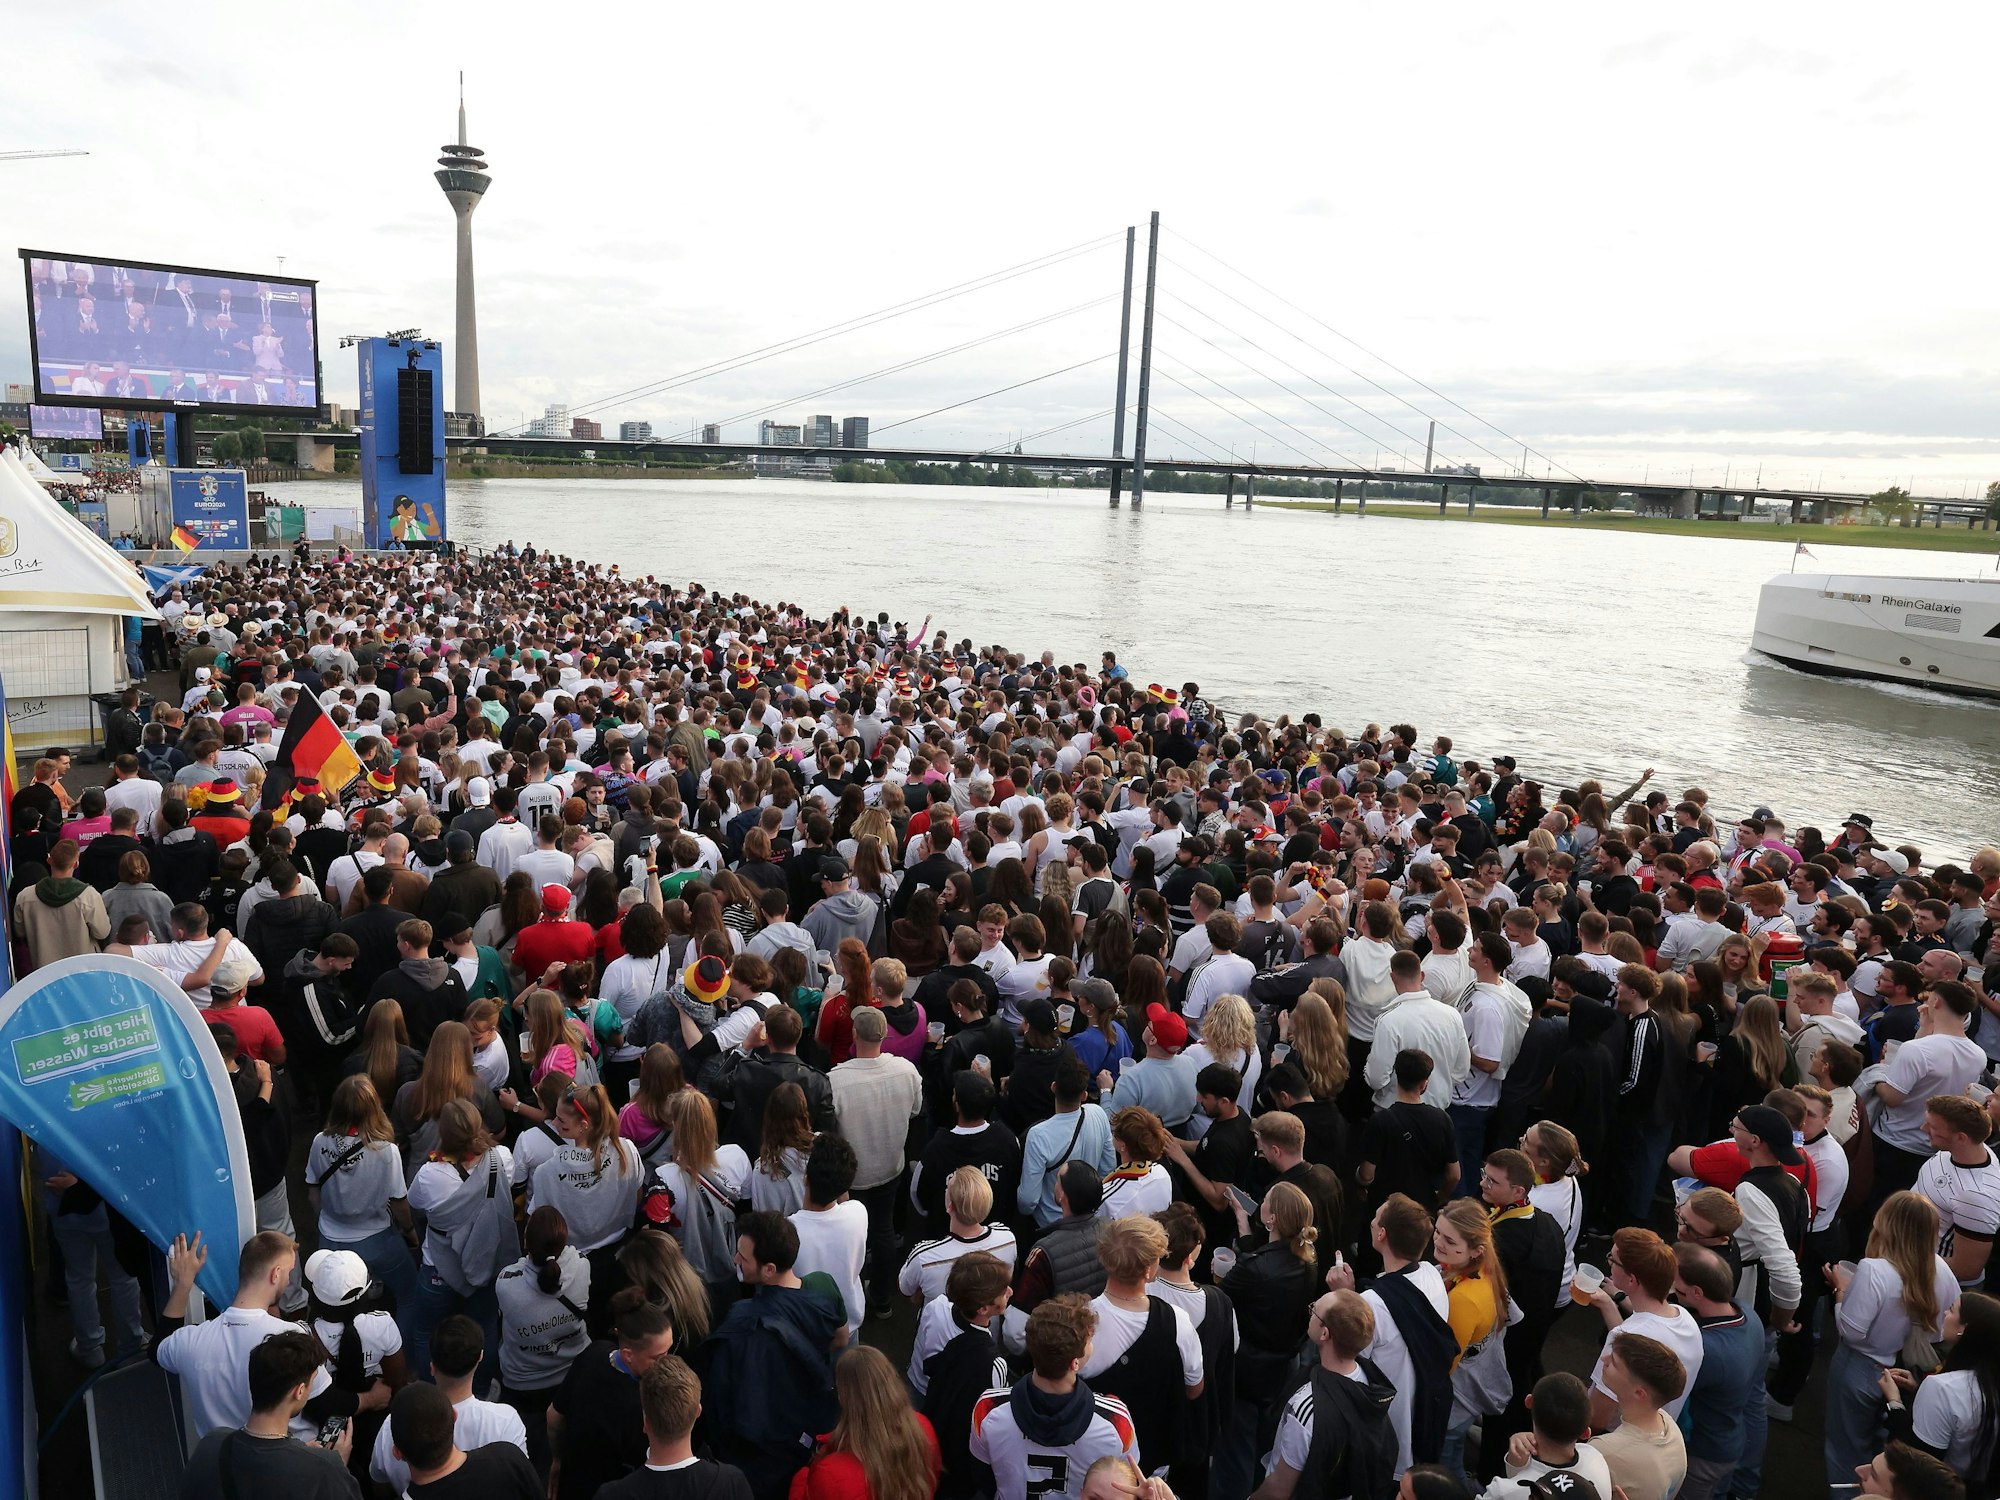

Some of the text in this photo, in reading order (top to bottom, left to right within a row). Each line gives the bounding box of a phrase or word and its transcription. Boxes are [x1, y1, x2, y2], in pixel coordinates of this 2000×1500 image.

[15, 558, 43, 570] Bit
[1881, 595, 1962, 614] RheinGalaxie
[23, 700, 47, 713] Bit
[238, 711, 255, 719] MÜLLER
[214, 763, 250, 771] EUTSCHLAND
[530, 795, 552, 803] MUSIALA
[1264, 934, 1285, 945] FN
[559, 1150, 569, 1162] FC
[517, 1327, 530, 1339] FC
